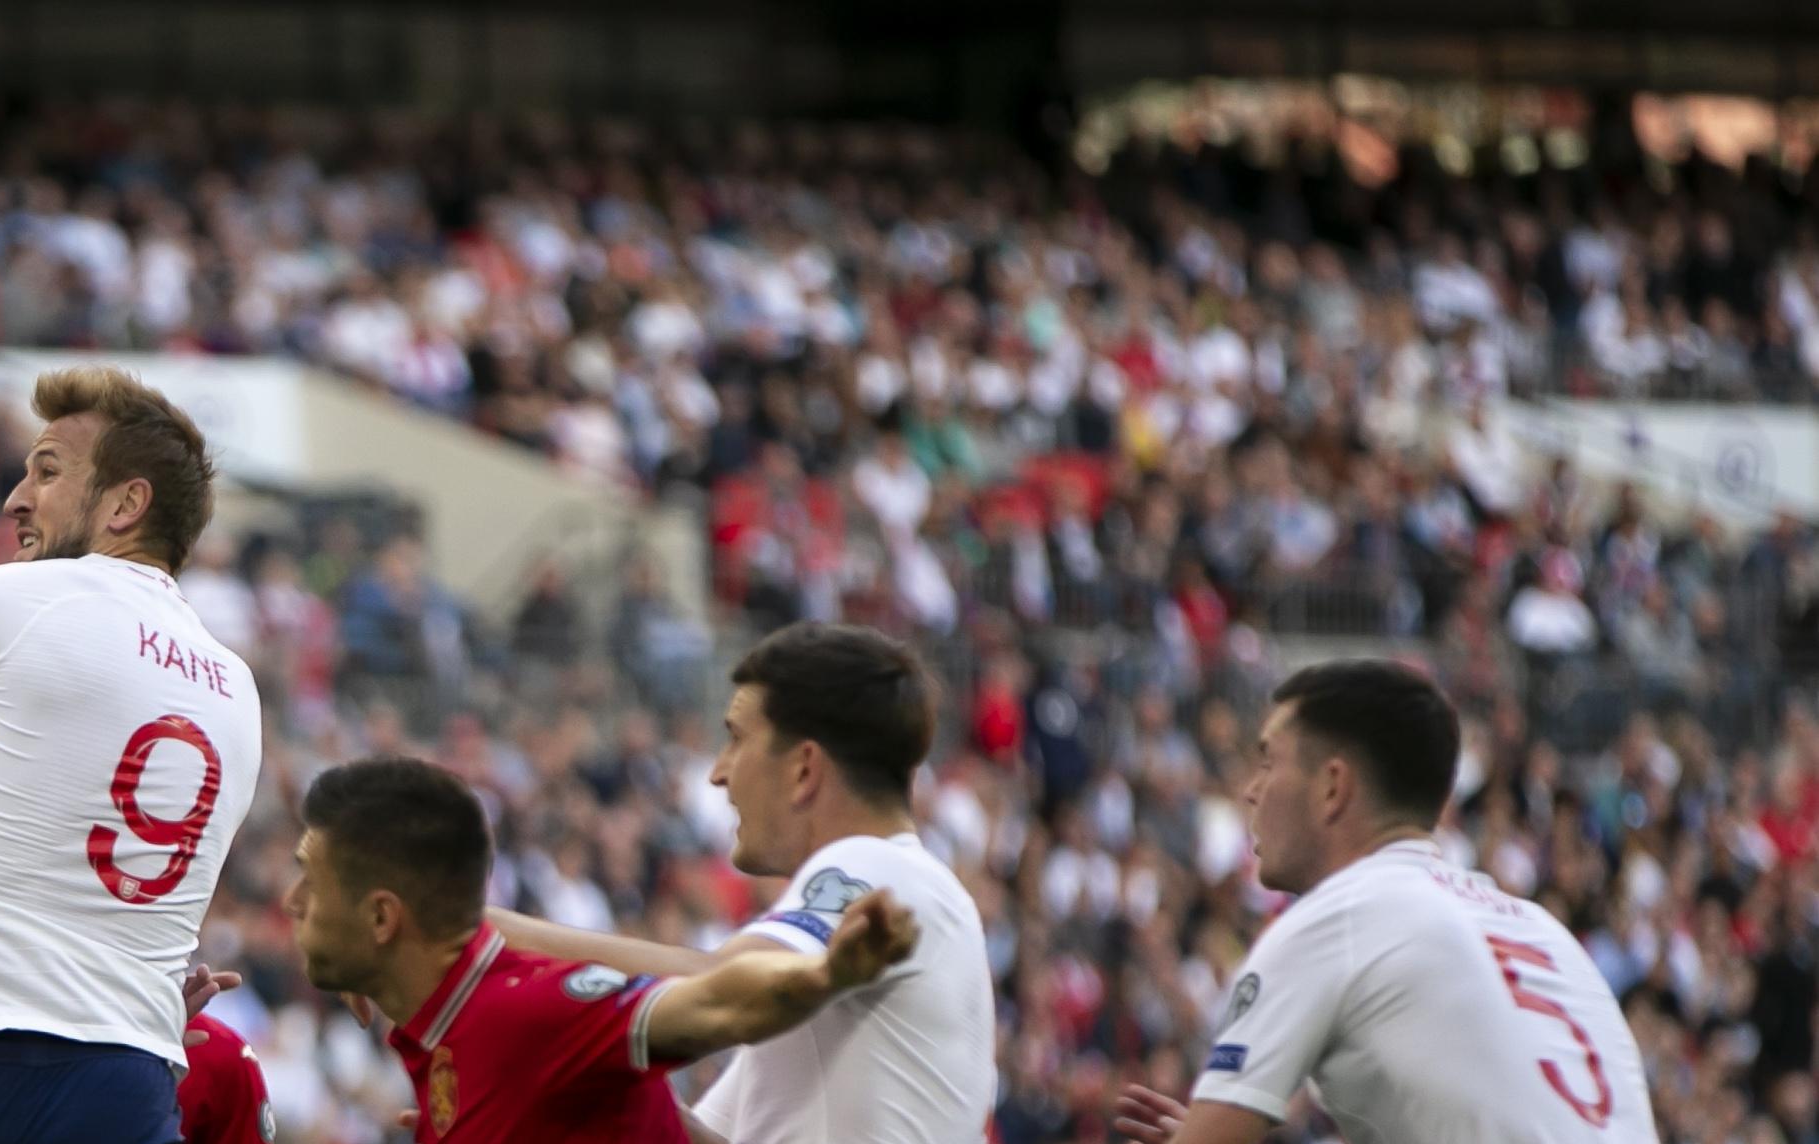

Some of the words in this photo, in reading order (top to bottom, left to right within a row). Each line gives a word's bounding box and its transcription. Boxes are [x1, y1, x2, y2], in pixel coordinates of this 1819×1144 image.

[138, 621, 234, 699] KANE
[84, 713, 222, 906] 9
[1485, 932, 1613, 1128] 5
